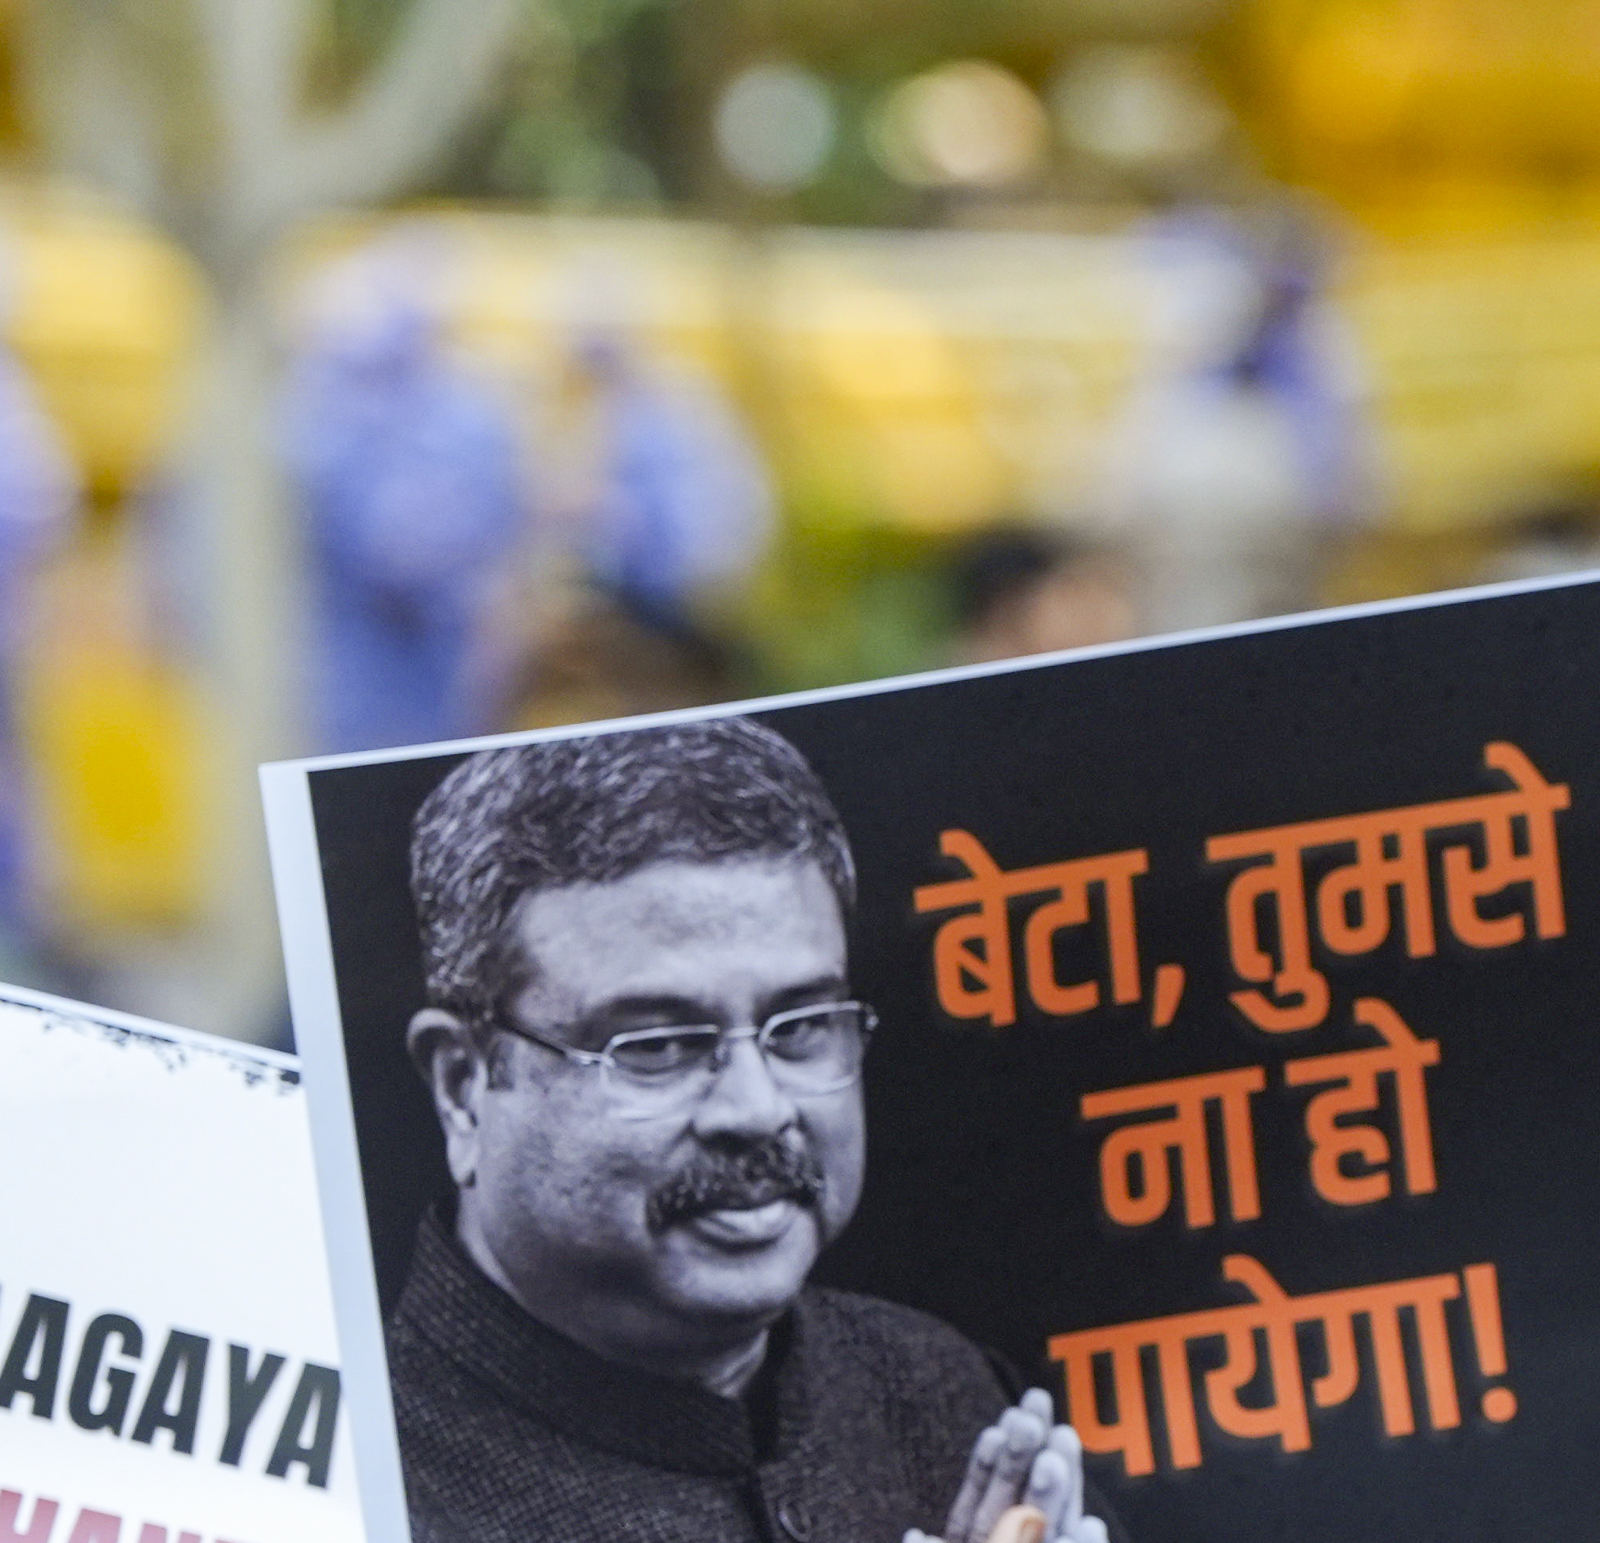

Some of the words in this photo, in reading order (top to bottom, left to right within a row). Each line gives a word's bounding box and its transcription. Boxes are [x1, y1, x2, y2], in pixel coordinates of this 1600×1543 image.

[914, 829, 1185, 1026] बेटा,
[1206, 741, 1571, 1033] तुमसे
[1082, 1066, 1265, 1228] ना
[1284, 998, 1440, 1206] हो
[0, 1293, 341, 1488] AGAYA
[1048, 1254, 1518, 1477] पायेगा!
